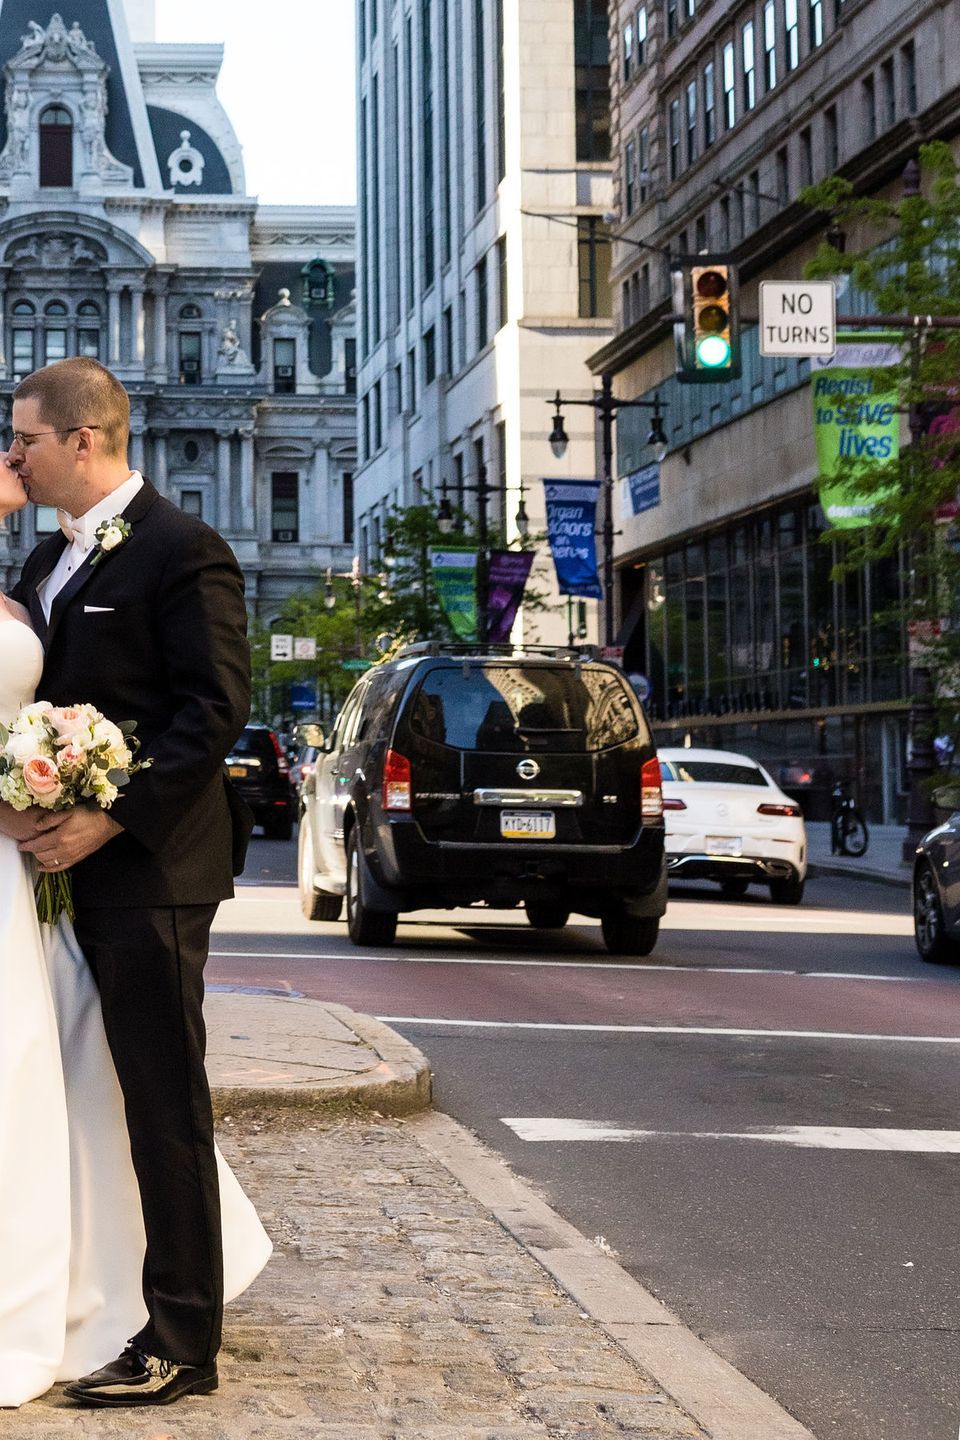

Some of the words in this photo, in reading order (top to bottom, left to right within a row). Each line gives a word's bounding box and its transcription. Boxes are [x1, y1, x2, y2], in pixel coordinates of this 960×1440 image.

[781, 292, 813, 314] NO
[766, 326, 830, 344] TURNS
[815, 406, 834, 425] to
[839, 428, 893, 459] lives
